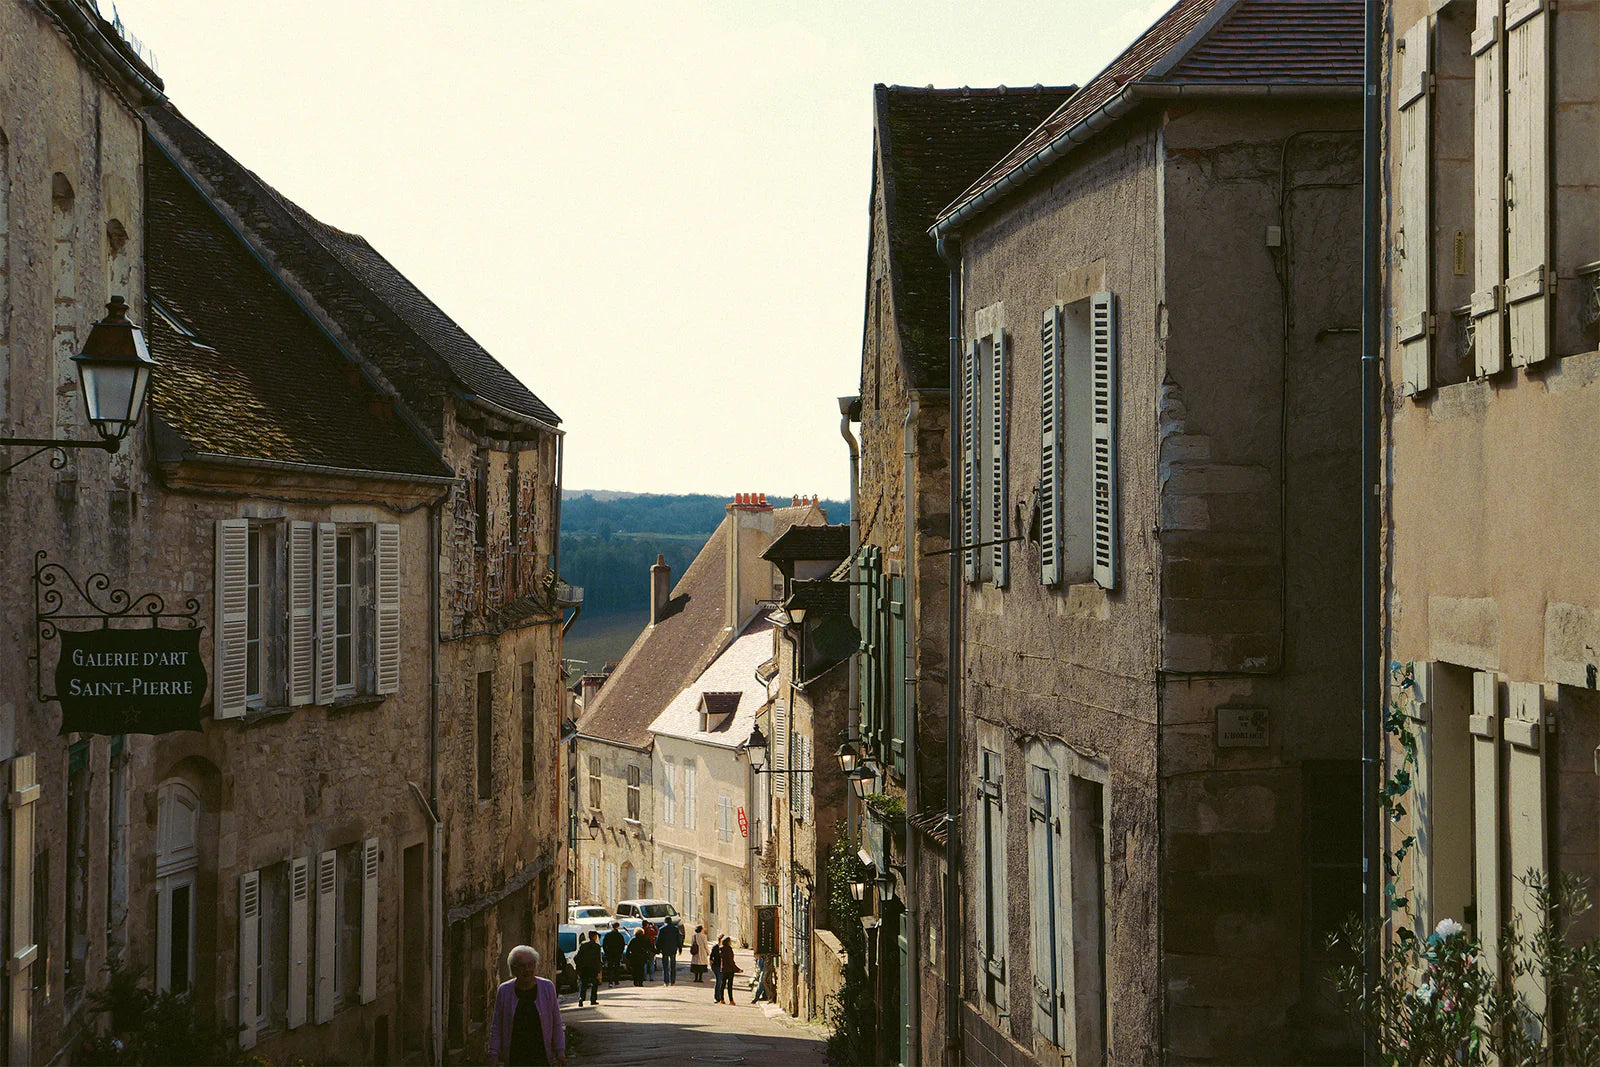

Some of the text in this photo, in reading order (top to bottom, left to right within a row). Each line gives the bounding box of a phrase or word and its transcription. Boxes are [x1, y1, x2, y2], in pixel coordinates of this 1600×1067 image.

[72, 648, 189, 666] GALERIE D'ART
[69, 678, 193, 696] SAINT-PIERRE
[738, 807, 747, 837] TABAC
